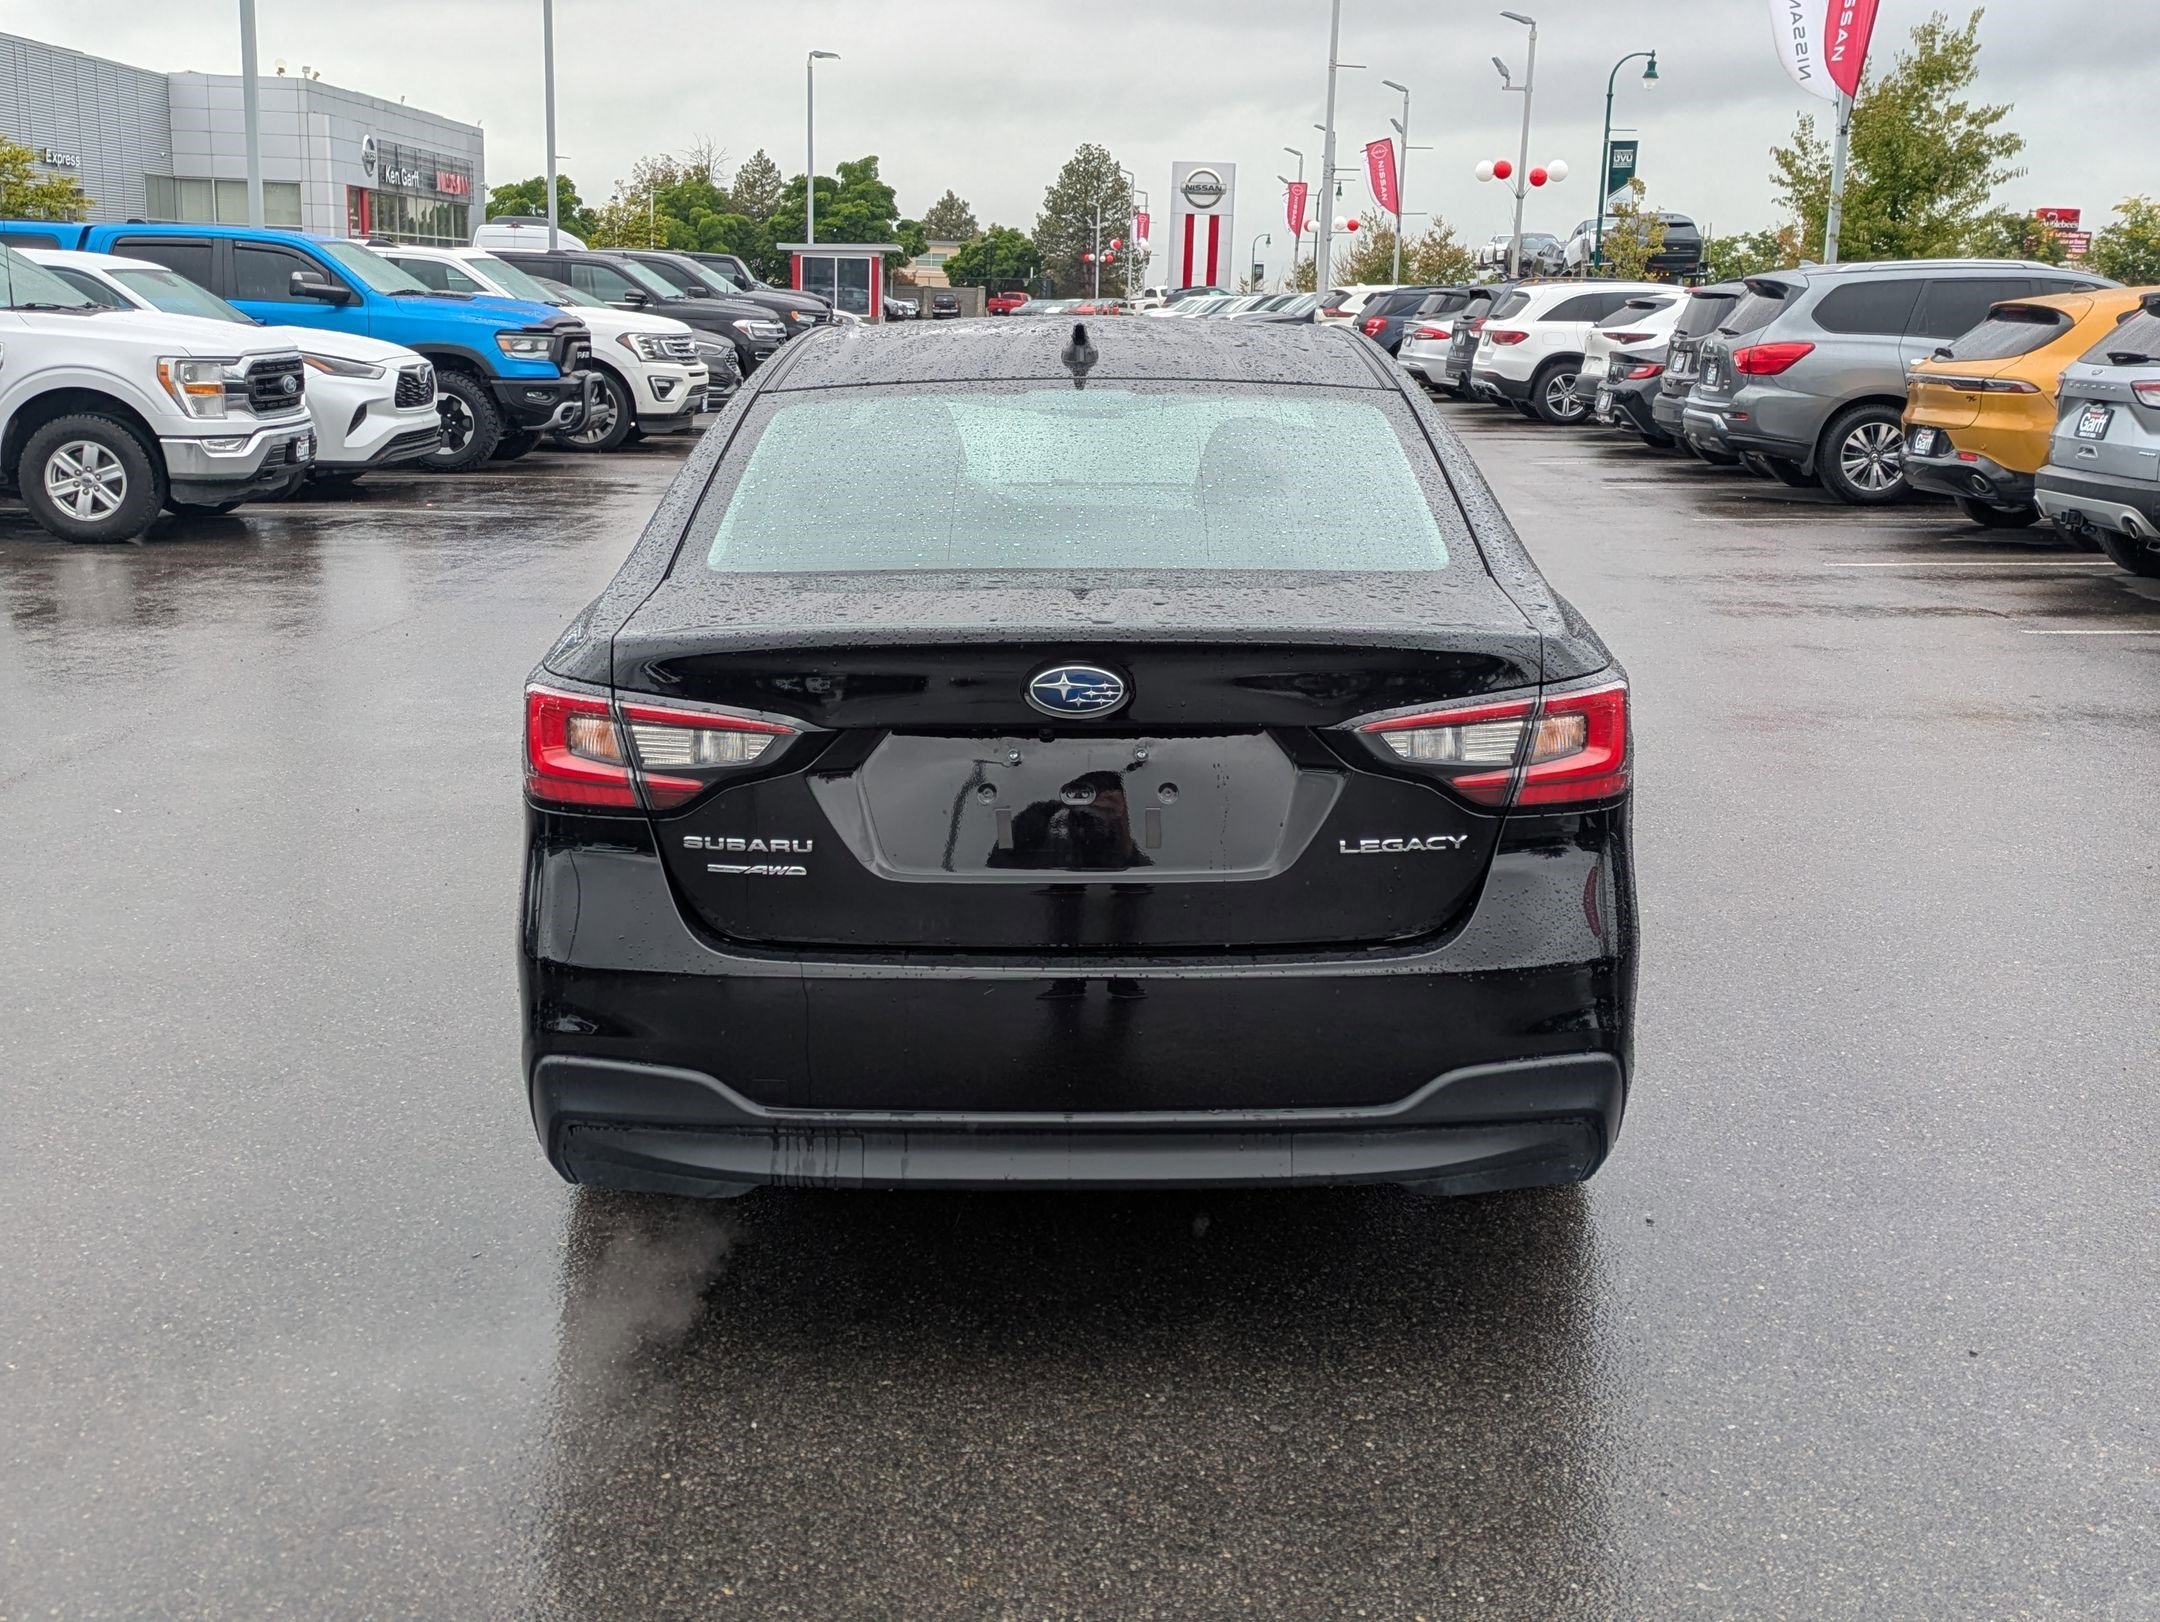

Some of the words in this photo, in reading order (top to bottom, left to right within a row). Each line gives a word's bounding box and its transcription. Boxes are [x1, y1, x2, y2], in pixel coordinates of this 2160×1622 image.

[45, 147, 81, 167] Express
[384, 164, 401, 184] Ken
[1377, 160, 1389, 201] NISSAN
[1184, 184, 1223, 192] NISSAN
[2080, 412, 2109, 433] Garff
[683, 835, 813, 853] SUBARU
[1339, 834, 1468, 854] LEGACY
[744, 865, 807, 876] AWD
